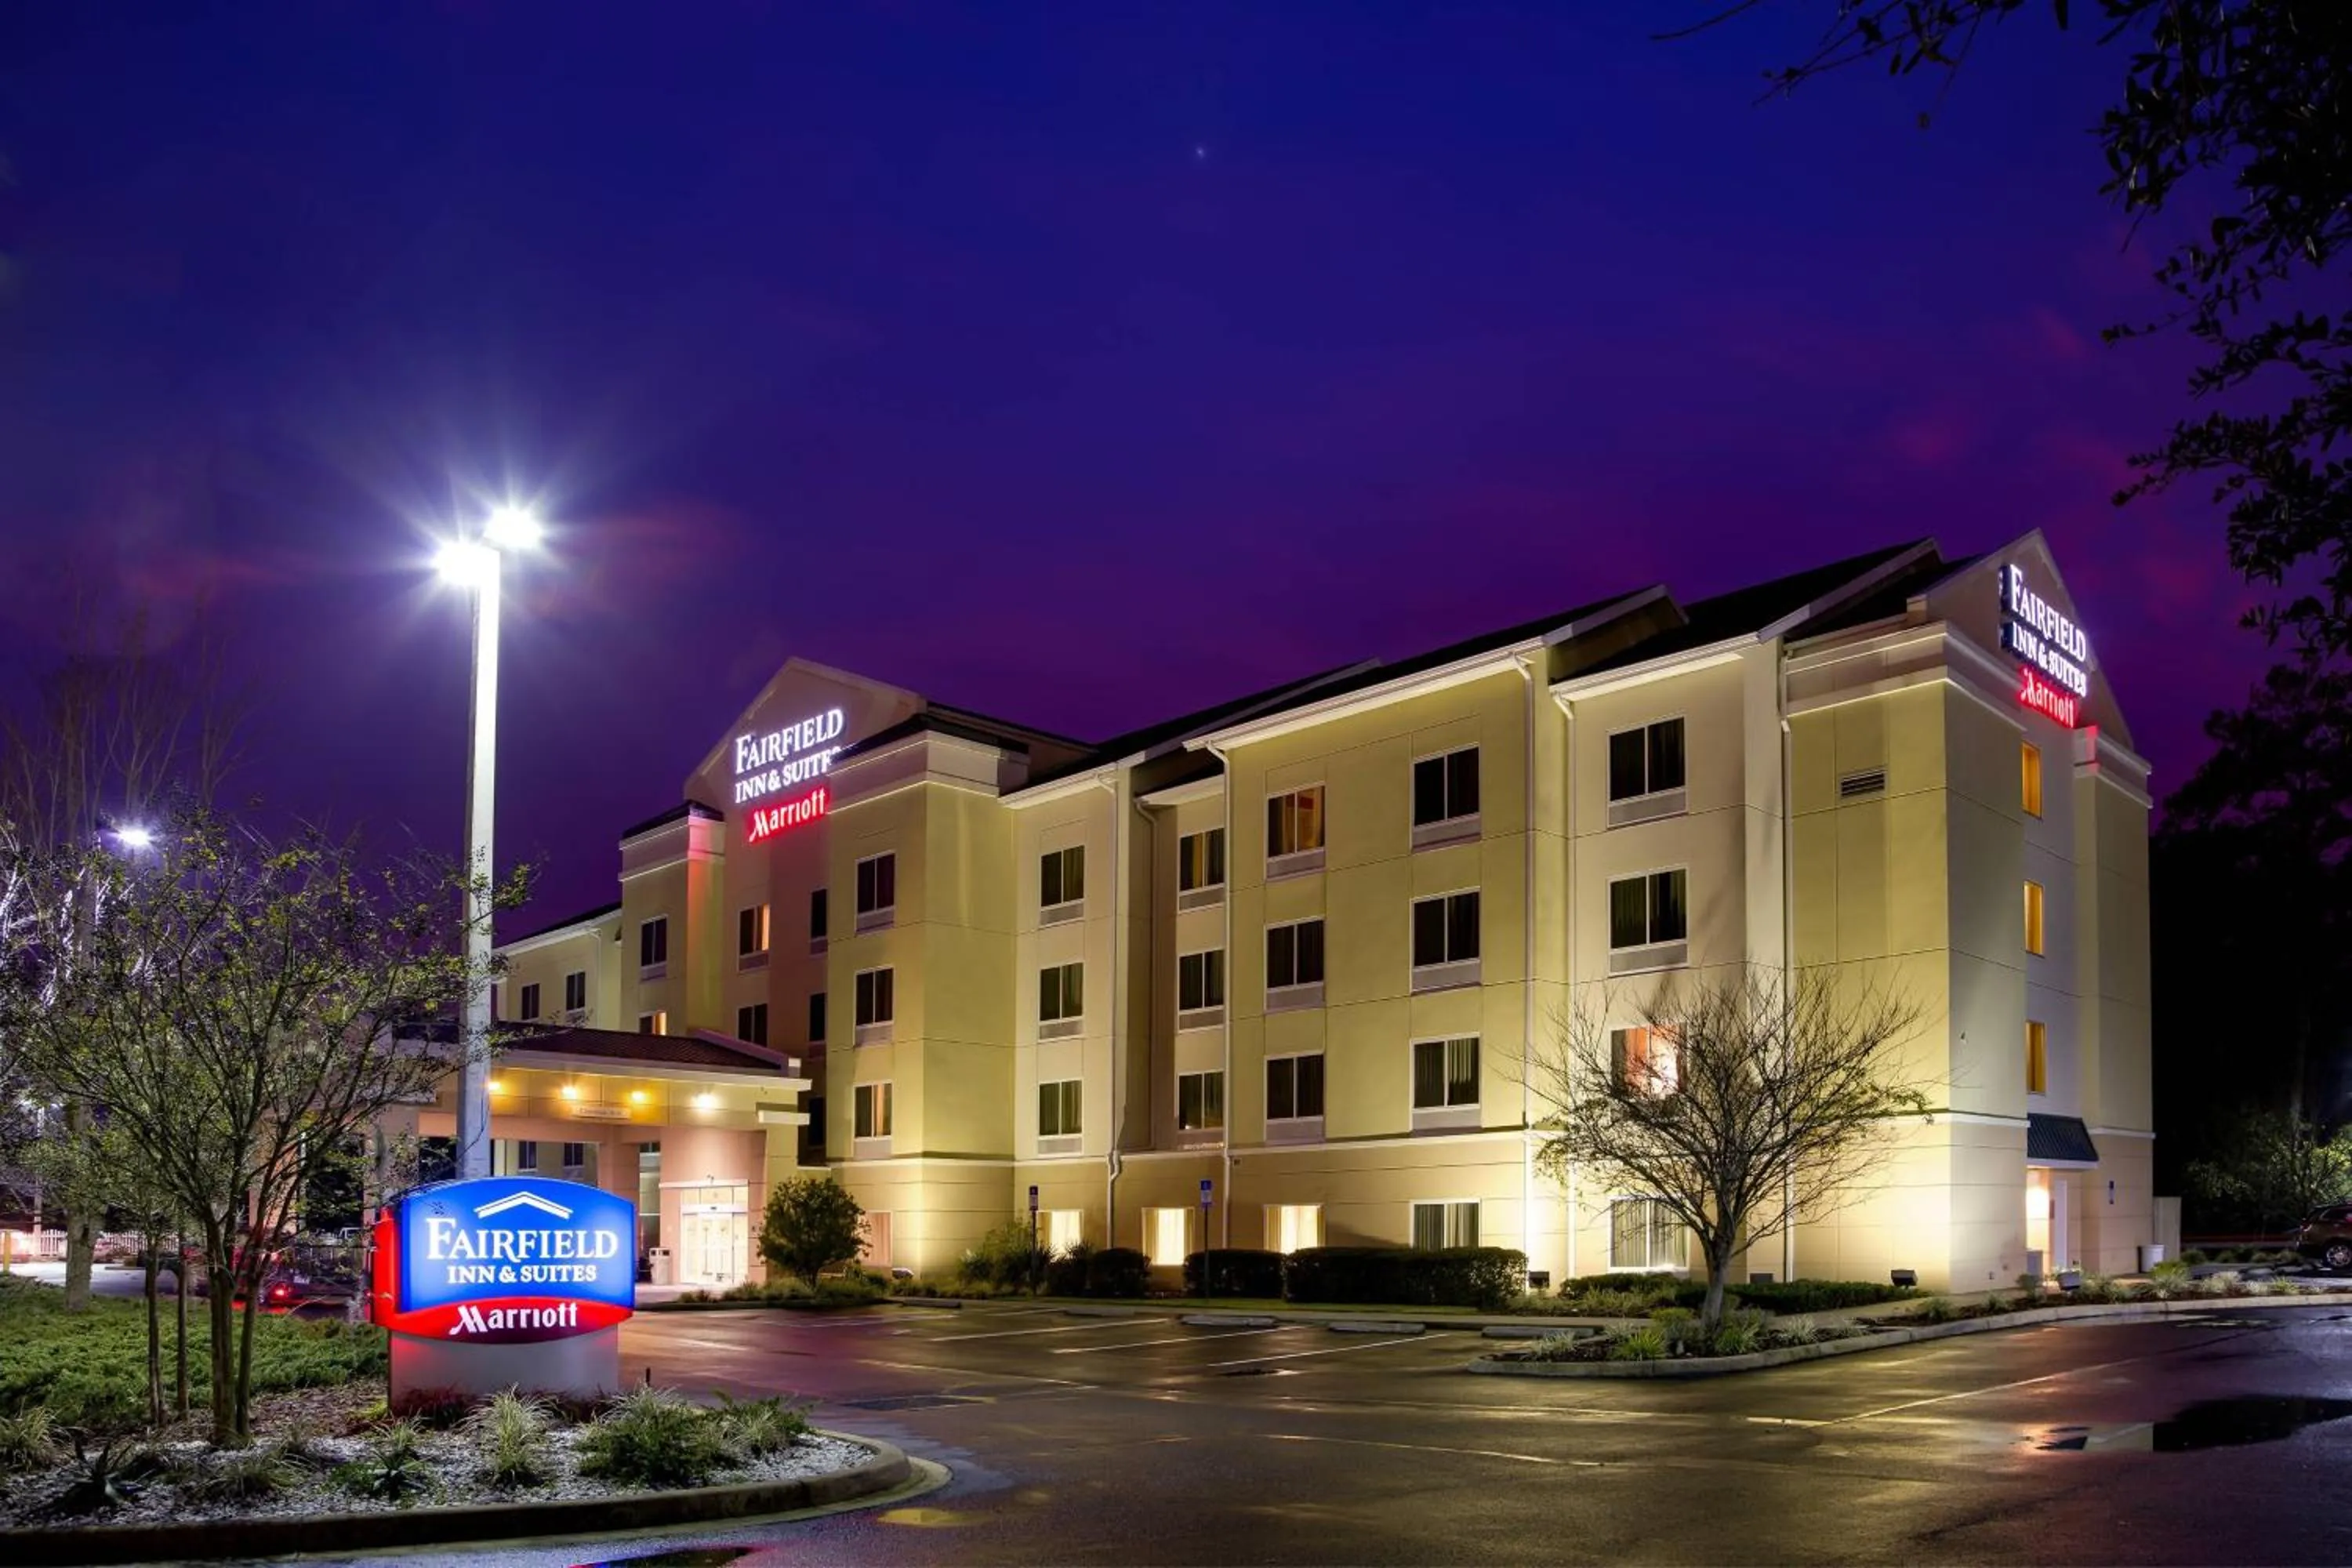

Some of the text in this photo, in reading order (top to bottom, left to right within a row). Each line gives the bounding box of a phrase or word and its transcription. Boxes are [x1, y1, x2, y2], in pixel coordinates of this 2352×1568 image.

[2009, 564, 2087, 662] FAIRFIELD
[2020, 668, 2074, 728] Marriott
[2049, 651, 2087, 698] SUITES
[735, 708, 844, 775] FAIRFIELD
[749, 786, 826, 842] Marriott
[426, 1218, 619, 1263] FAIRFIELD
[447, 1265, 597, 1284] INN & SUITES
[448, 1302, 579, 1336] Marriott
